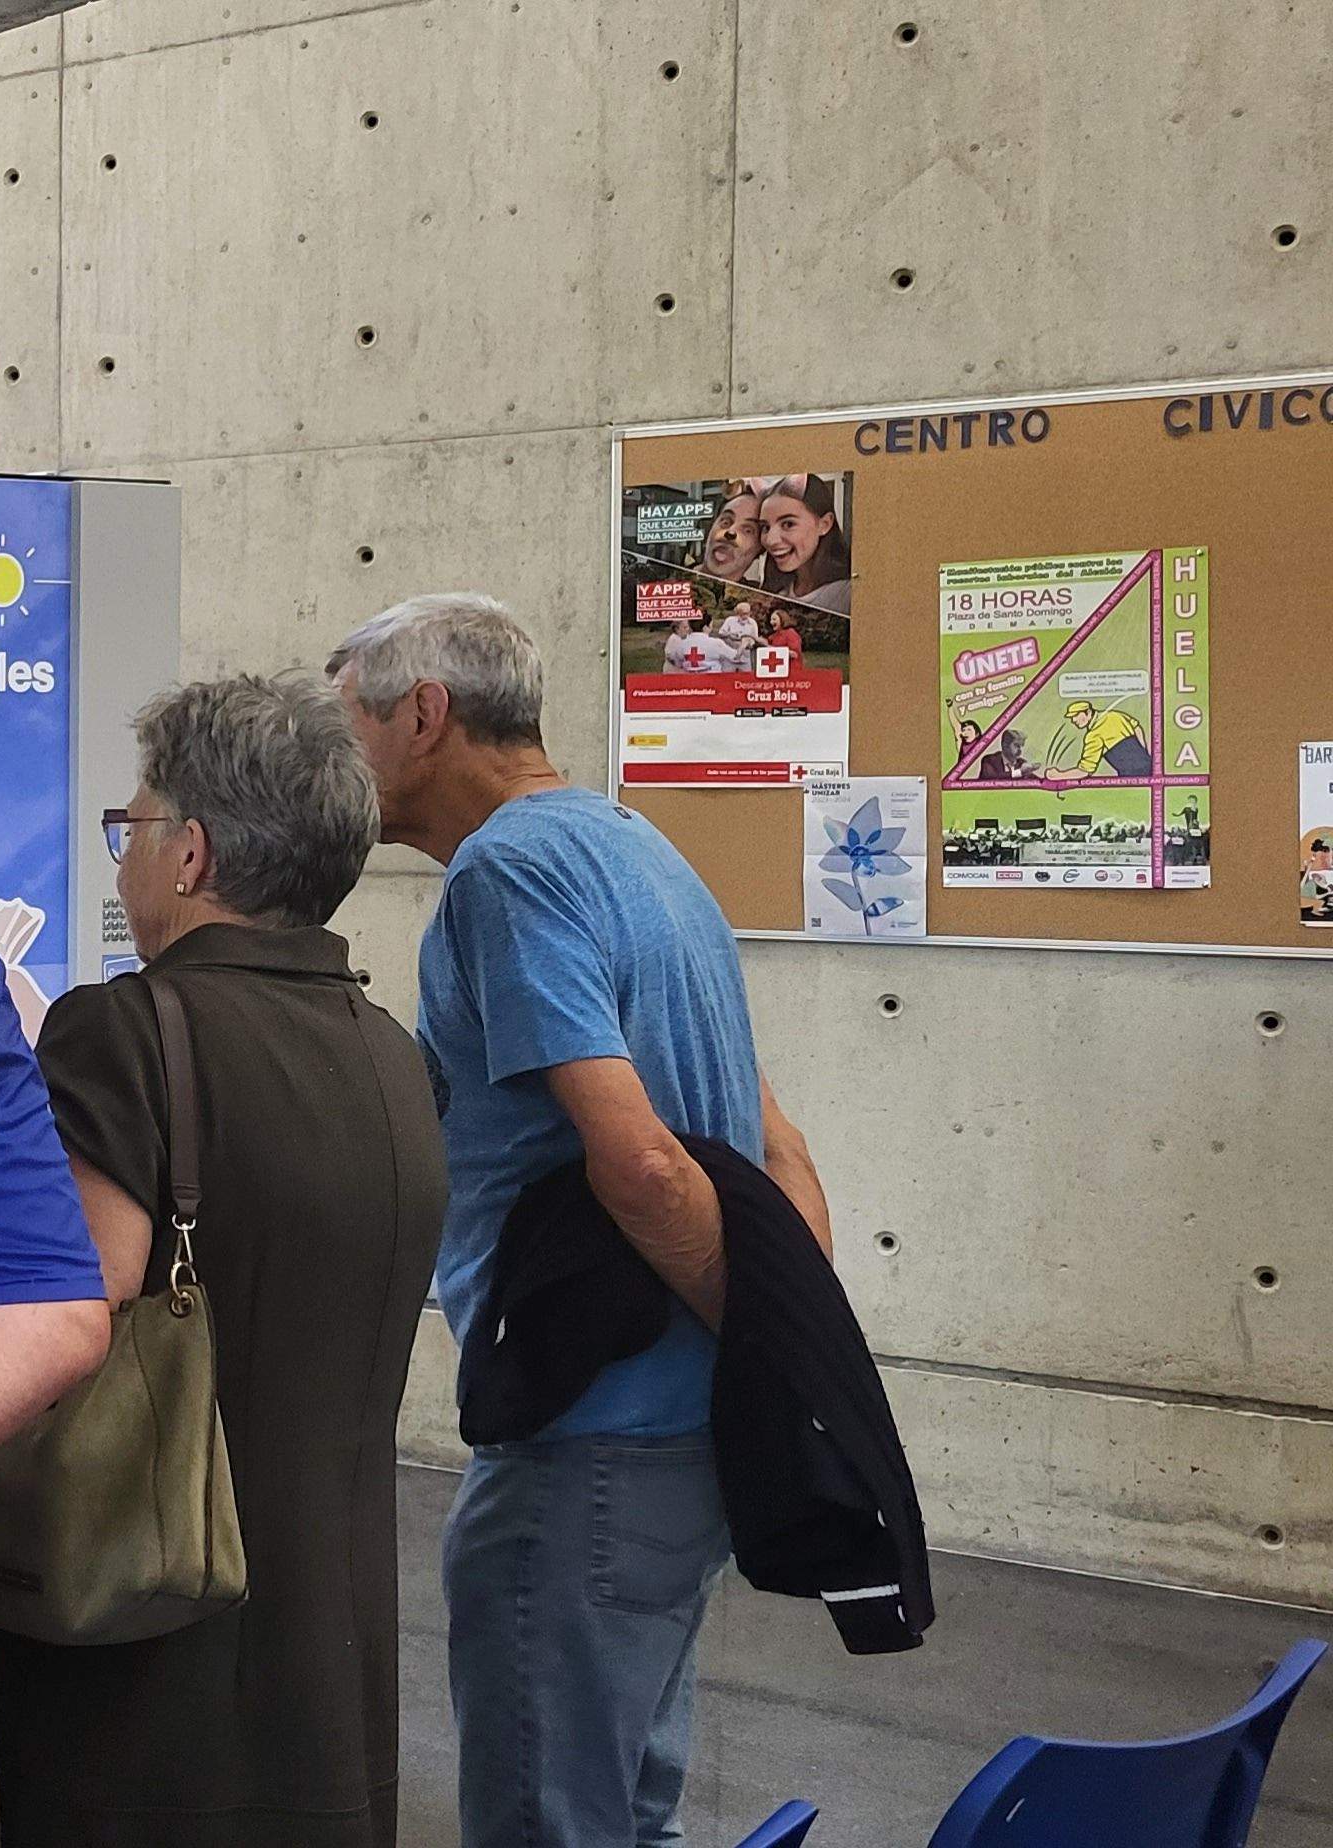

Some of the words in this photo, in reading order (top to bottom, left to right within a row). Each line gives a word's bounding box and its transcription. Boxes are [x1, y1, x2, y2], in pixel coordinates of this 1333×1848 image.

[854, 408, 1051, 456] CENTRO
[640, 505, 674, 519] HAY
[674, 502, 713, 516] APPS
[640, 521, 660, 530] QUE
[661, 519, 694, 528] SACAN
[640, 532, 660, 541] UNA
[661, 530, 704, 540] SONRISA
[640, 584, 650, 596] Y
[653, 583, 691, 595] APPS
[639, 600, 659, 609] QUE
[660, 599, 693, 607] SACAN
[947, 594, 973, 611] 18
[982, 588, 1073, 610] HORAS
[639, 611, 659, 619] UNA
[661, 610, 702, 618] SONRISA
[947, 612, 975, 621] Plaza
[978, 611, 991, 620] de
[994, 609, 1023, 619] Santo
[1026, 607, 1073, 619] Domingo
[956, 642, 1036, 681] ÚNETE
[1173, 556, 1202, 767] HUELGA
[734, 680, 773, 690] Descarga
[774, 681, 786, 690] ya
[786, 680, 794, 689] la
[795, 681, 812, 690] app
[955, 690, 974, 702] con
[974, 687, 987, 696] tu
[988, 676, 1025, 693] familia
[747, 690, 771, 702] Cruz
[773, 689, 798, 704] Roja
[959, 704, 967, 716] y
[809, 768, 824, 776] Cruz
[825, 768, 840, 777] Roja
[811, 782, 851, 790] MÁSTERES
